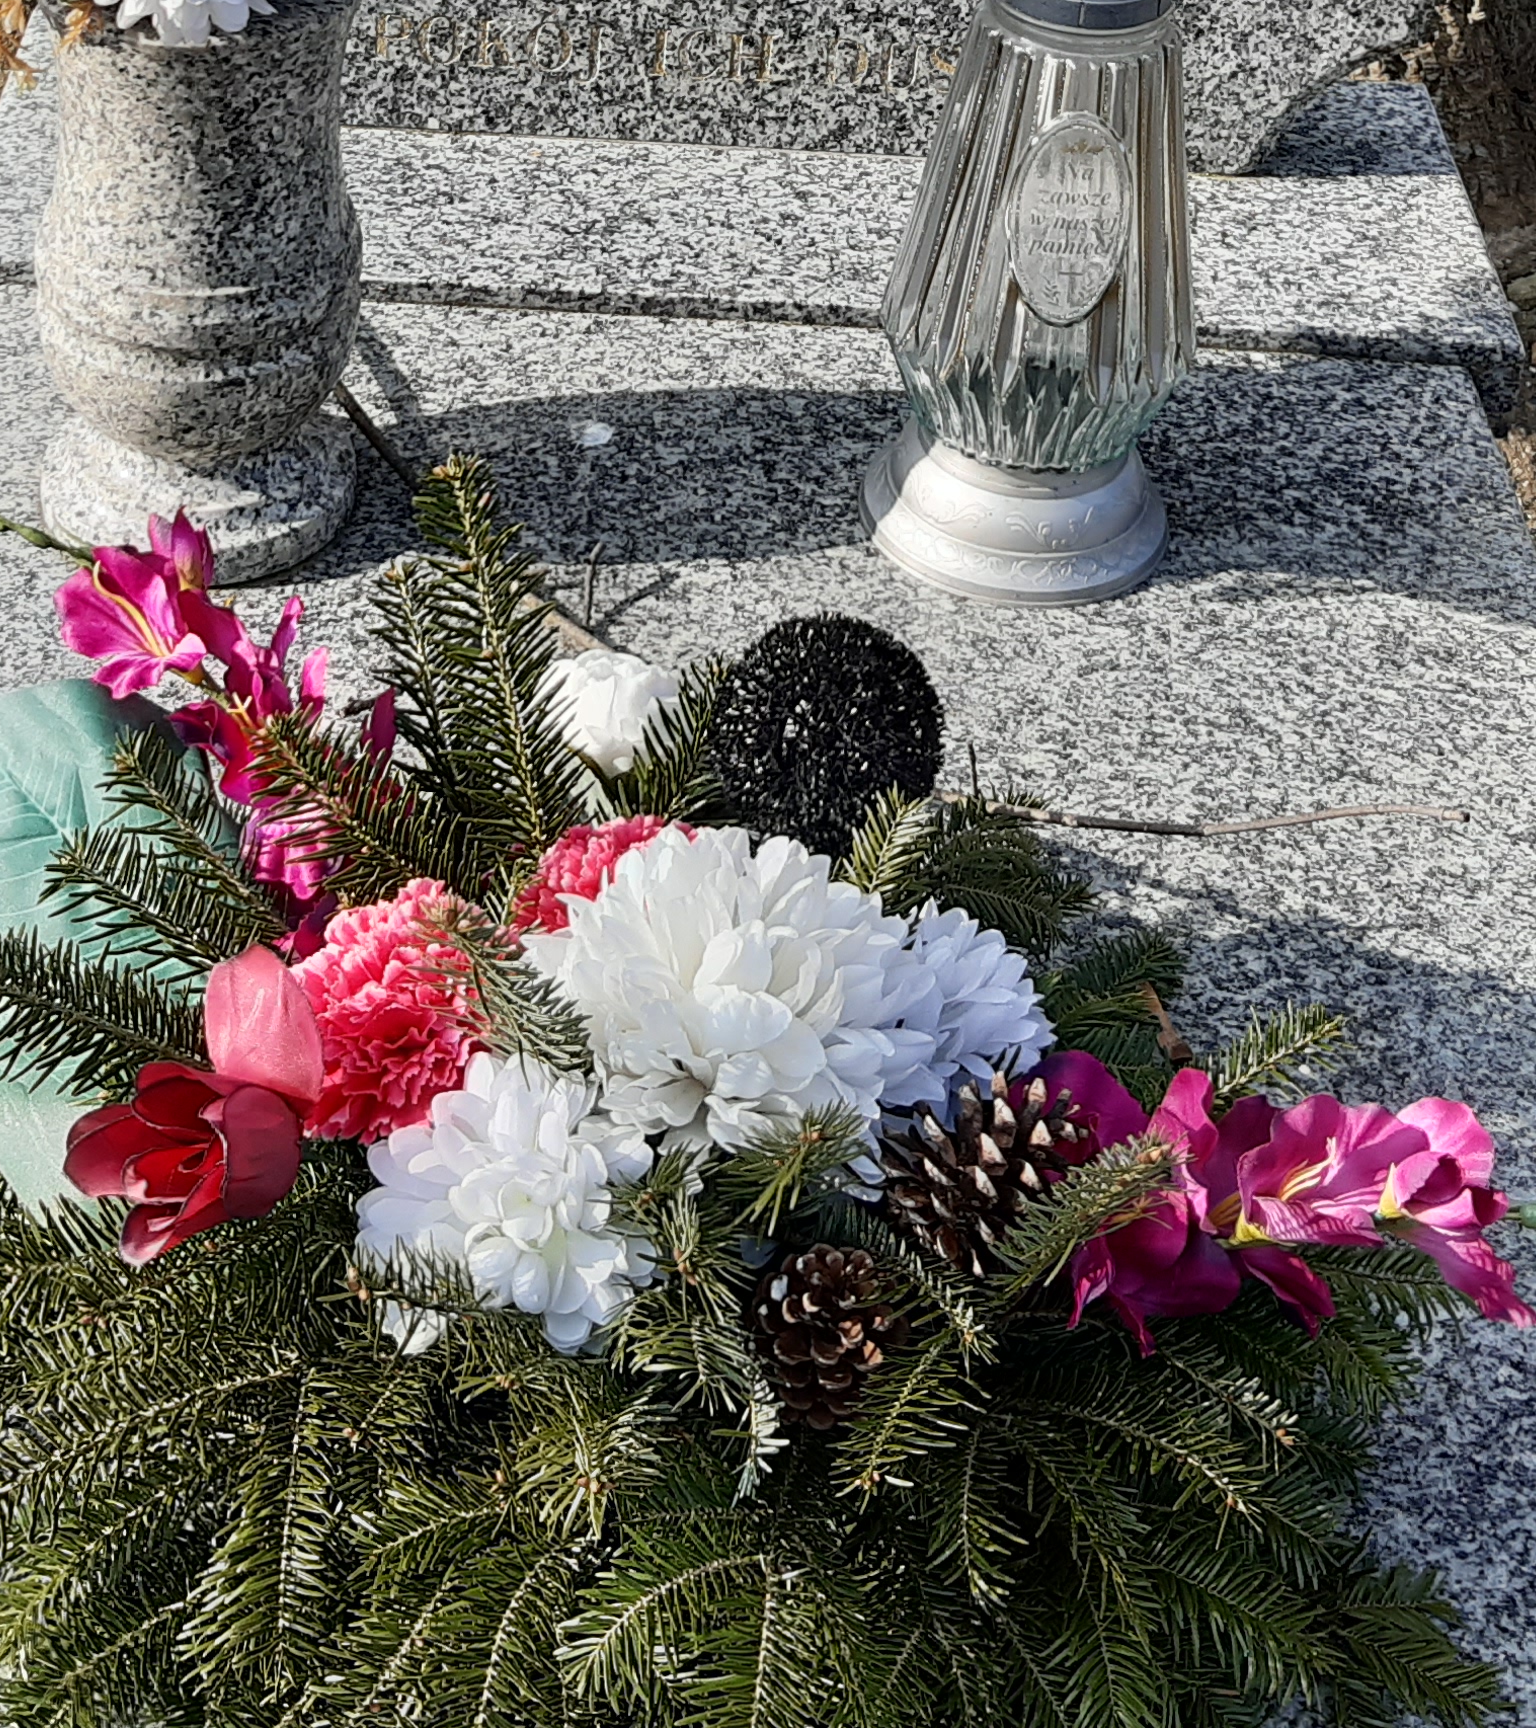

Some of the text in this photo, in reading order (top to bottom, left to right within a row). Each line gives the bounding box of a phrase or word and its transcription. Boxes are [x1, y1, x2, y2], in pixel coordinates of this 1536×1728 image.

[375, 7, 606, 85] POKÓJ
[652, 27, 778, 83] ICH
[1038, 190, 1112, 208] zawsze
